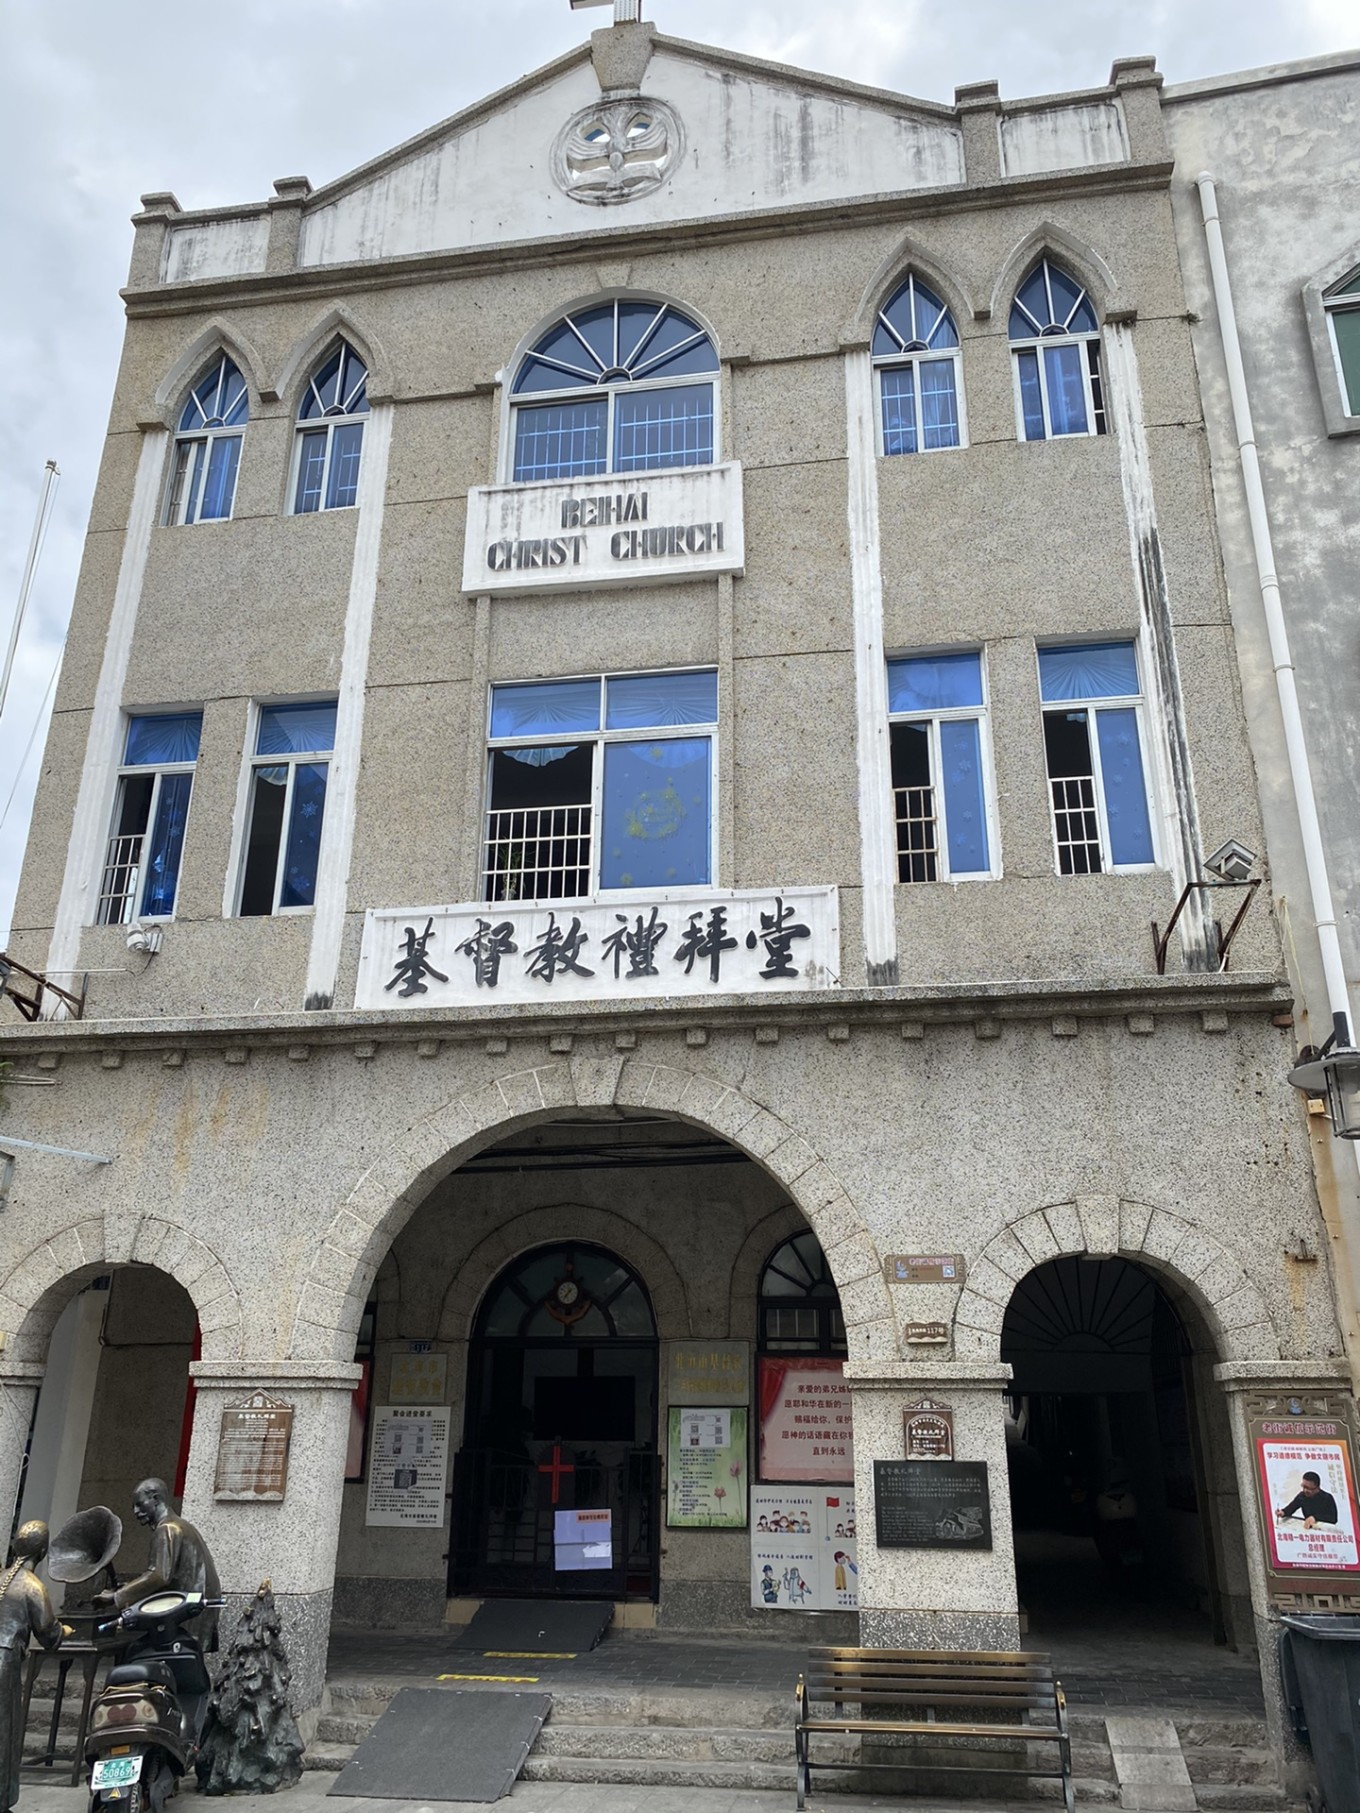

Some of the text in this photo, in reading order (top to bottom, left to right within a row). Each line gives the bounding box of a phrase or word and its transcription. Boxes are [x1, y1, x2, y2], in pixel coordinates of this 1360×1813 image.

[560, 491, 649, 529] BEIHAI
[487, 521, 725, 571] CHRIST CHURCH
[384, 896, 812, 998] 基督教禮拜堂
[784, 1399, 852, 1409] 愿耶和华在新的一
[812, 1446, 845, 1456] 直到永远
